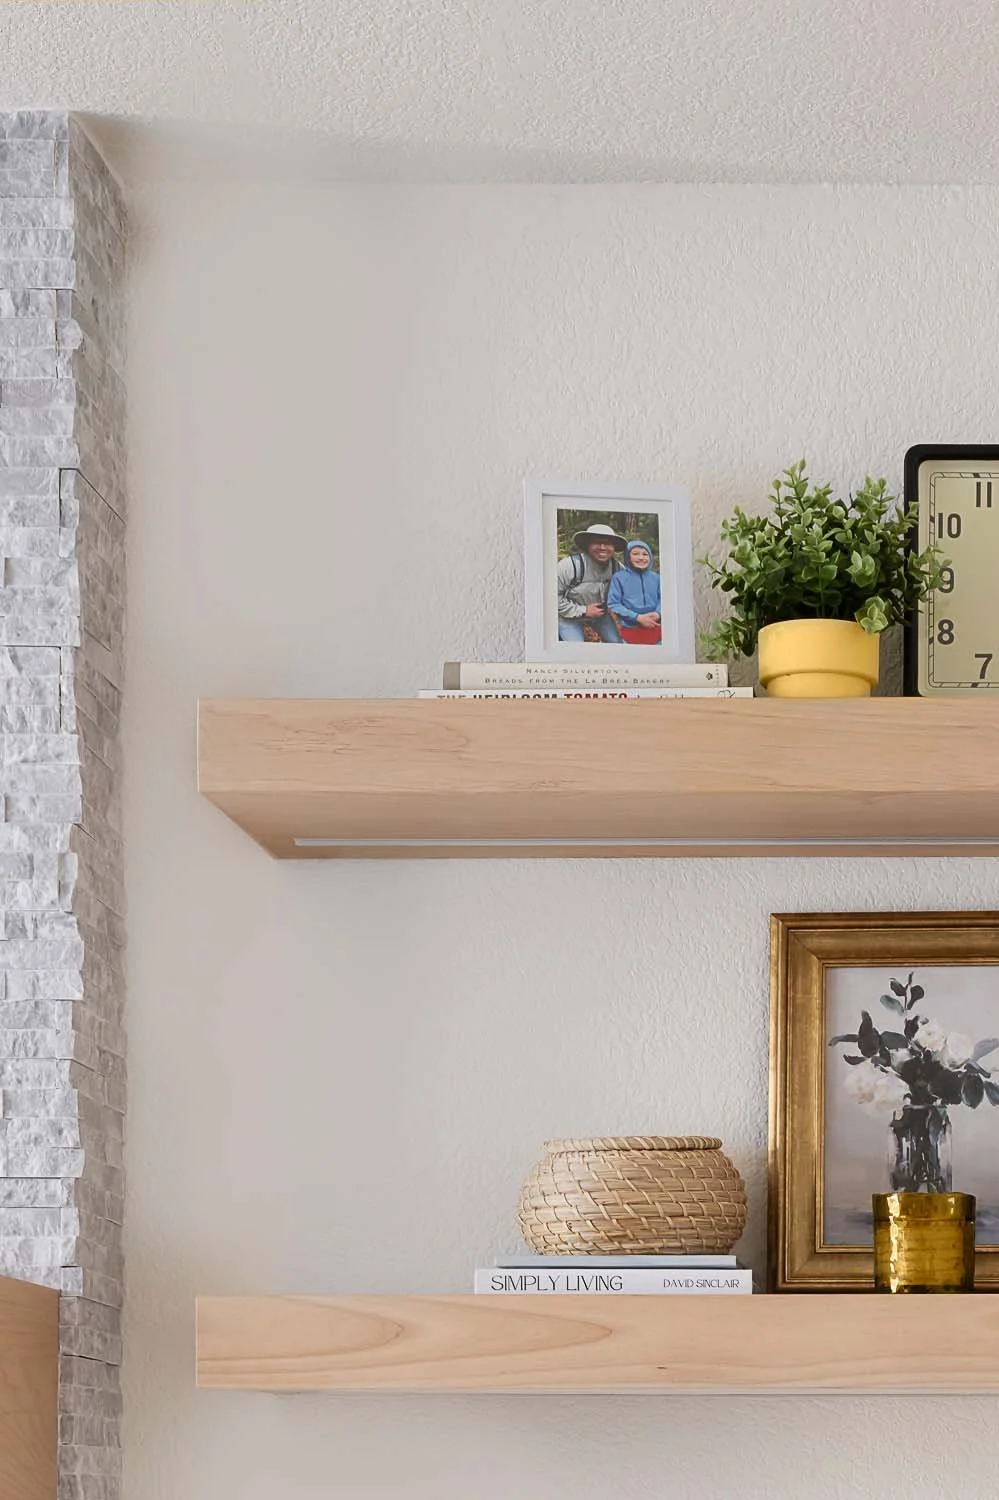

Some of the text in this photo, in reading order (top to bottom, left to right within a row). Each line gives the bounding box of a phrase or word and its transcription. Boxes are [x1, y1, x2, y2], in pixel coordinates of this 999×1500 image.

[975, 481, 992, 508] 11
[938, 512, 962, 539] 10
[938, 567, 955, 593] 9
[937, 619, 954, 645] 8
[974, 653, 993, 680] 7
[491, 1275, 623, 1291] SIMPLY LIVING
[663, 1278, 740, 1288] DAVID SINCLAIR
